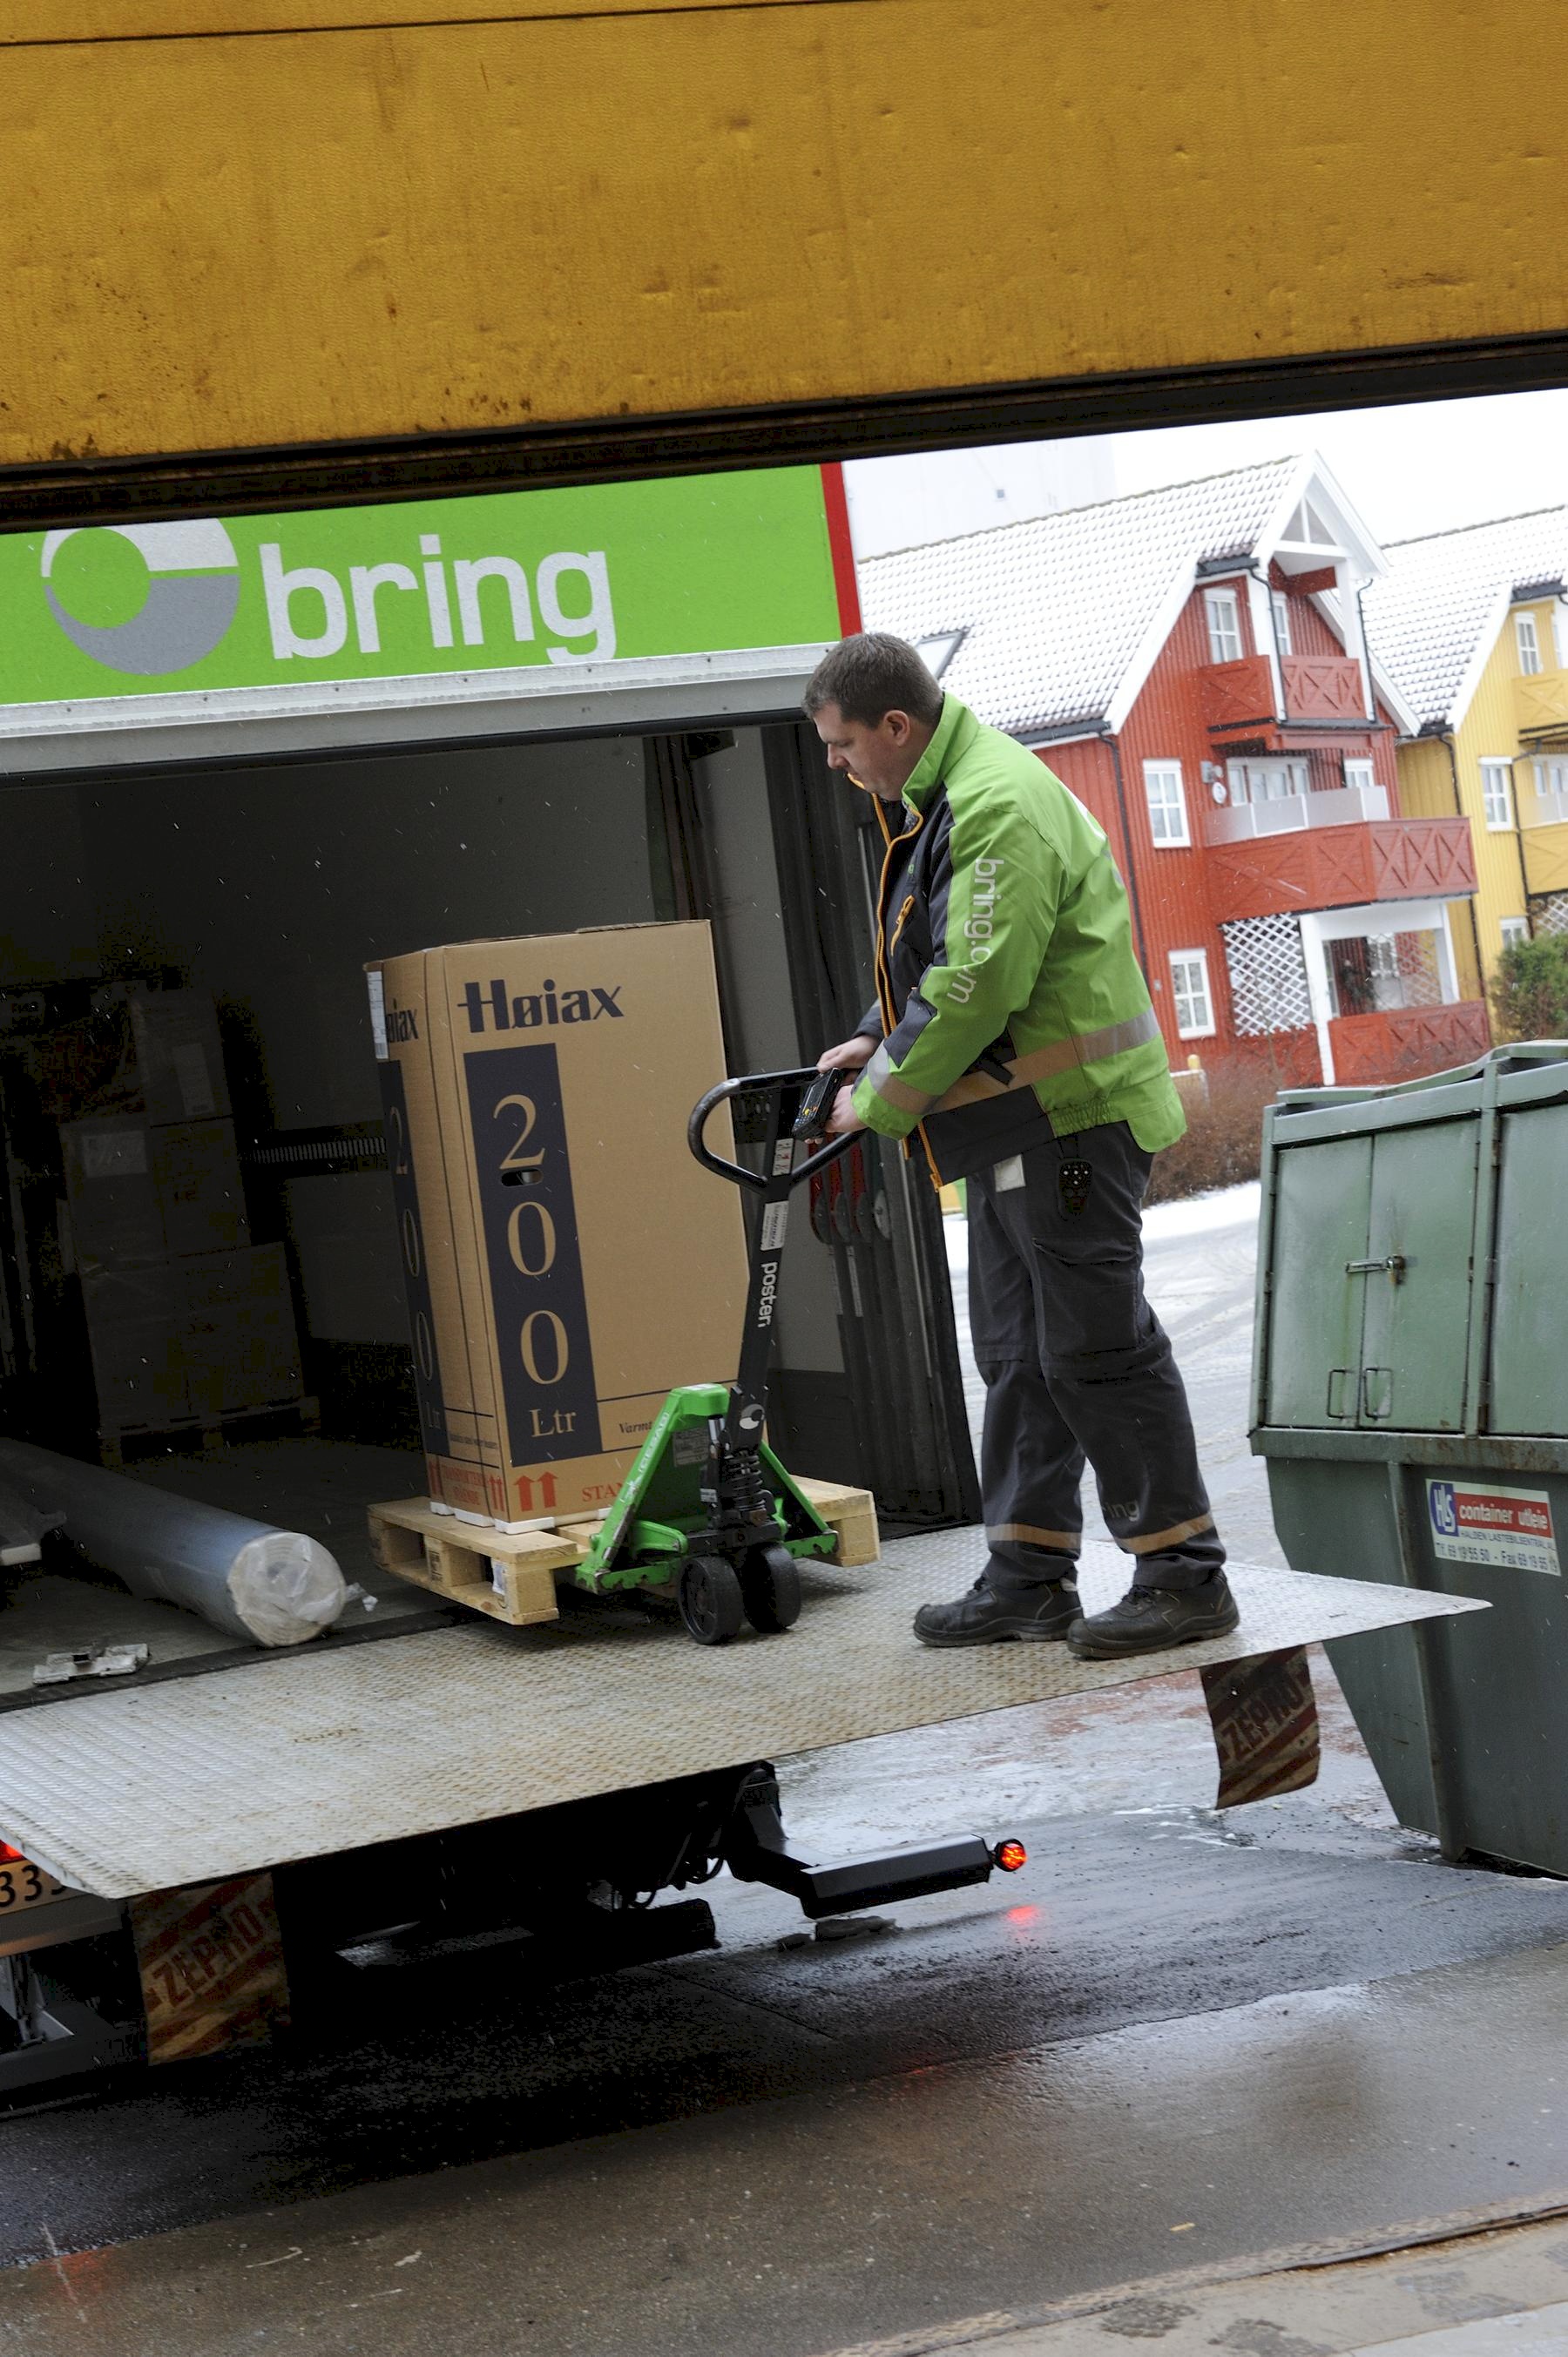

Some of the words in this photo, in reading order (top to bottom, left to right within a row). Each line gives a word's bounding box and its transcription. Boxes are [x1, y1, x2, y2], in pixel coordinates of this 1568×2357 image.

[259, 533, 617, 665] bring
[946, 857, 1004, 1004] bring.cm
[457, 978, 625, 1033] Høiax
[757, 1260, 778, 1329] posten
[530, 1408, 578, 1438] Ltr
[1459, 1502, 1514, 1524] container
[1517, 1508, 1549, 1530] utleie
